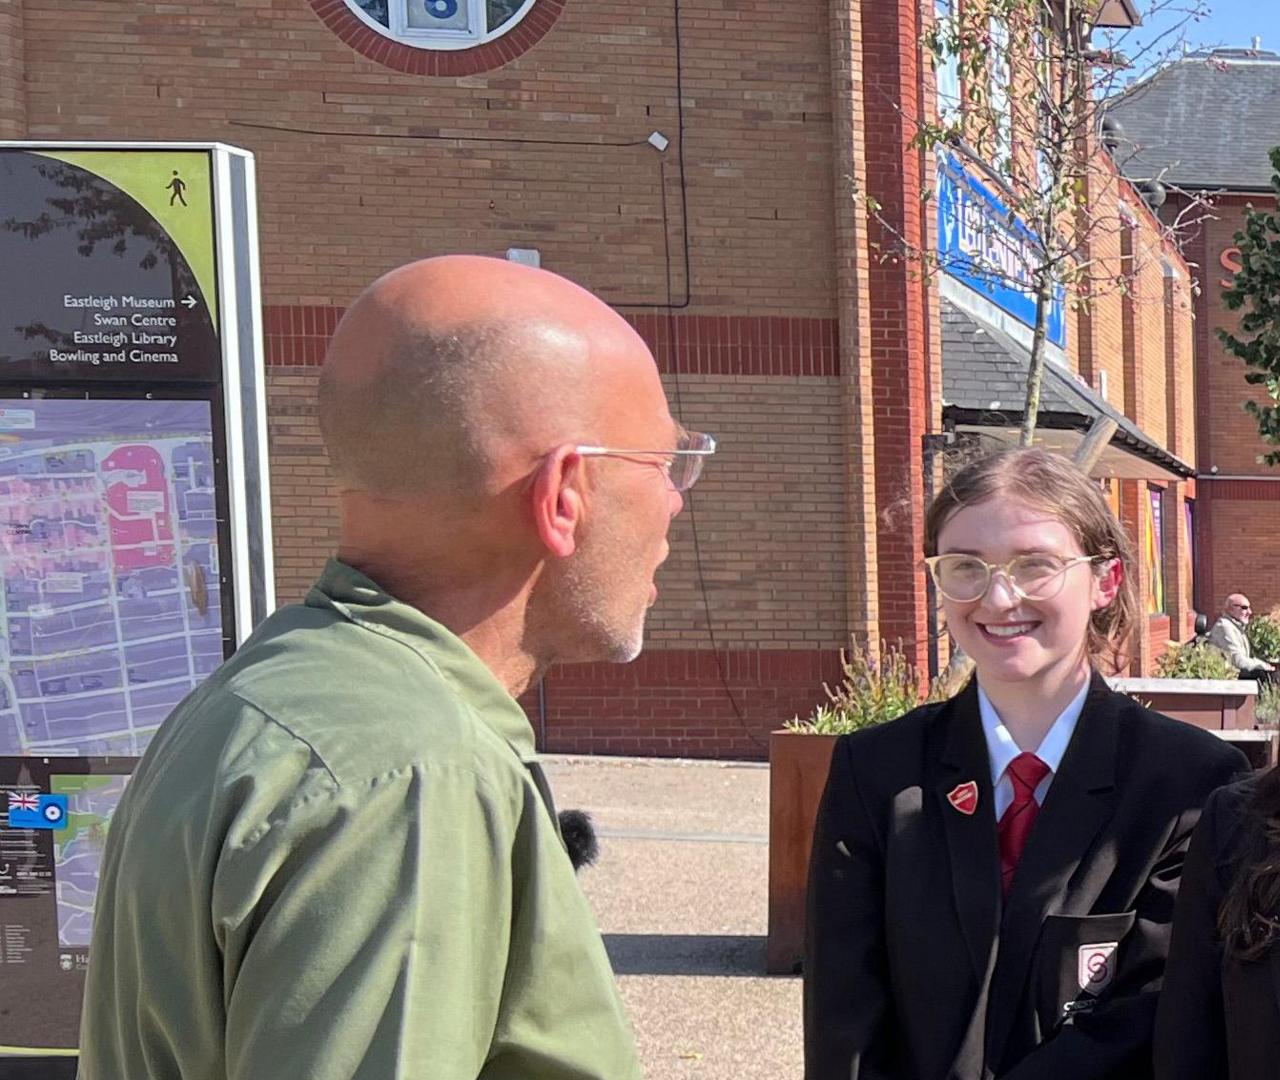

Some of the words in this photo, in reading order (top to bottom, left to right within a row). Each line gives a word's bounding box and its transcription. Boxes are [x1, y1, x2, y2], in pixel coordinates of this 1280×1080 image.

[64, 295, 118, 311] Eastleigh
[122, 295, 175, 308] Museum
[94, 313, 127, 326] Swan
[131, 313, 176, 326] Centre
[73, 331, 128, 347] Eastleigh
[131, 331, 177, 347] Library
[50, 350, 99, 365] Bowling
[103, 351, 125, 362] and
[129, 350, 179, 362] Cinema
